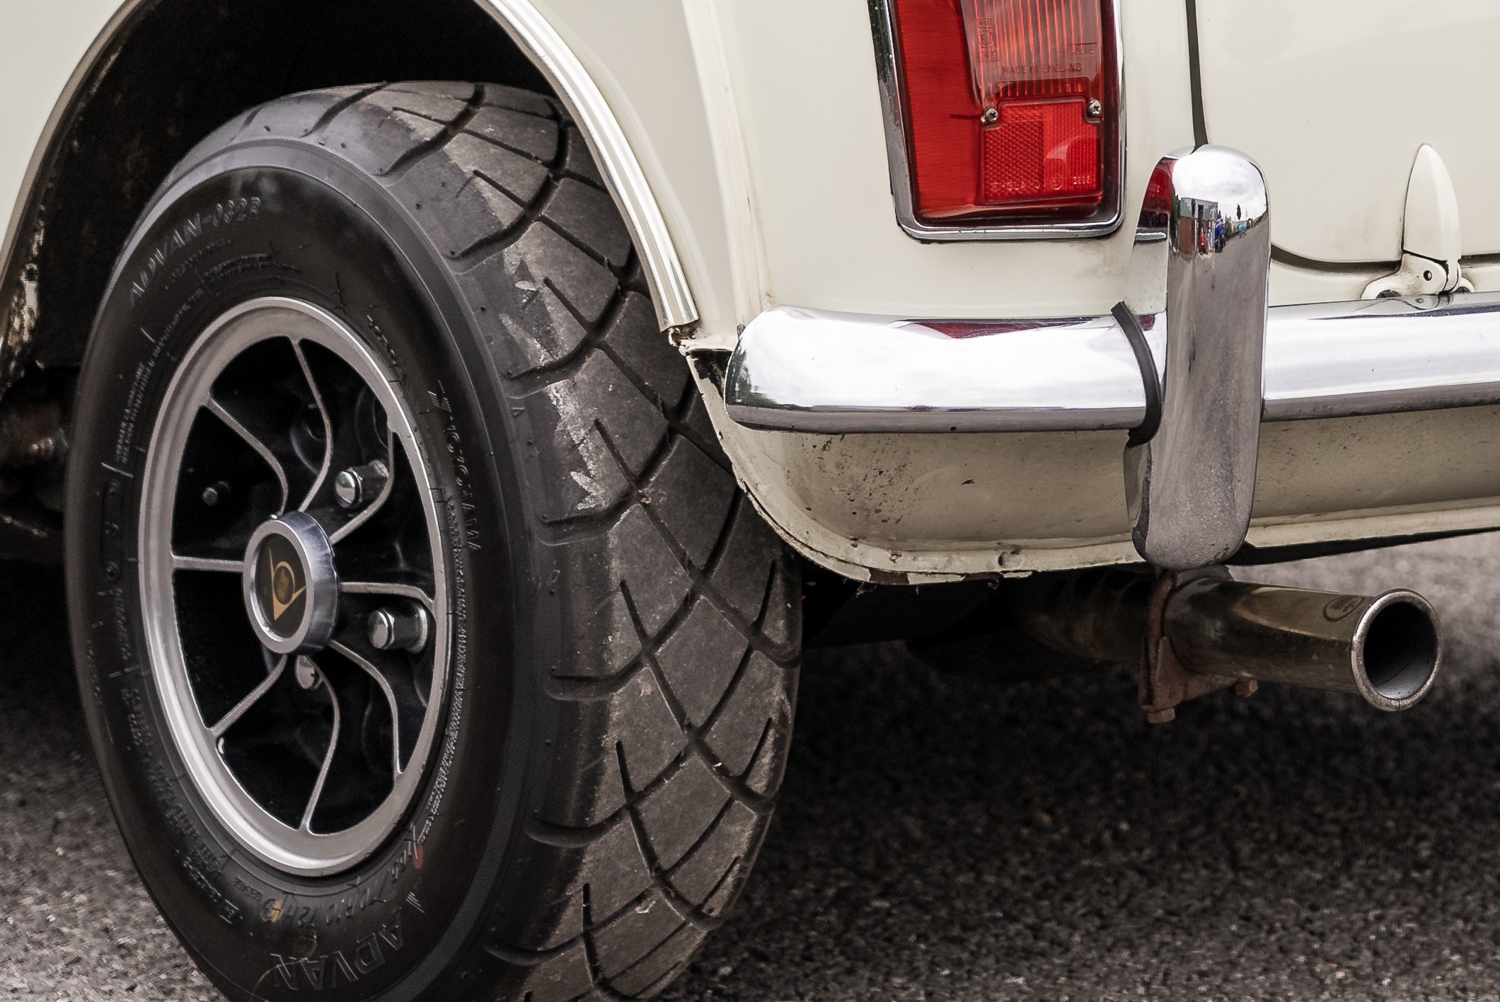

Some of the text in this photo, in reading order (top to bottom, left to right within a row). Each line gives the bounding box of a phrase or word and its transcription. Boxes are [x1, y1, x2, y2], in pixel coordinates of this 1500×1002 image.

[1002, 65, 1027, 75] MADE
[1042, 62, 1082, 73] ENGLAND
[270, 905, 404, 991] ADVAN
